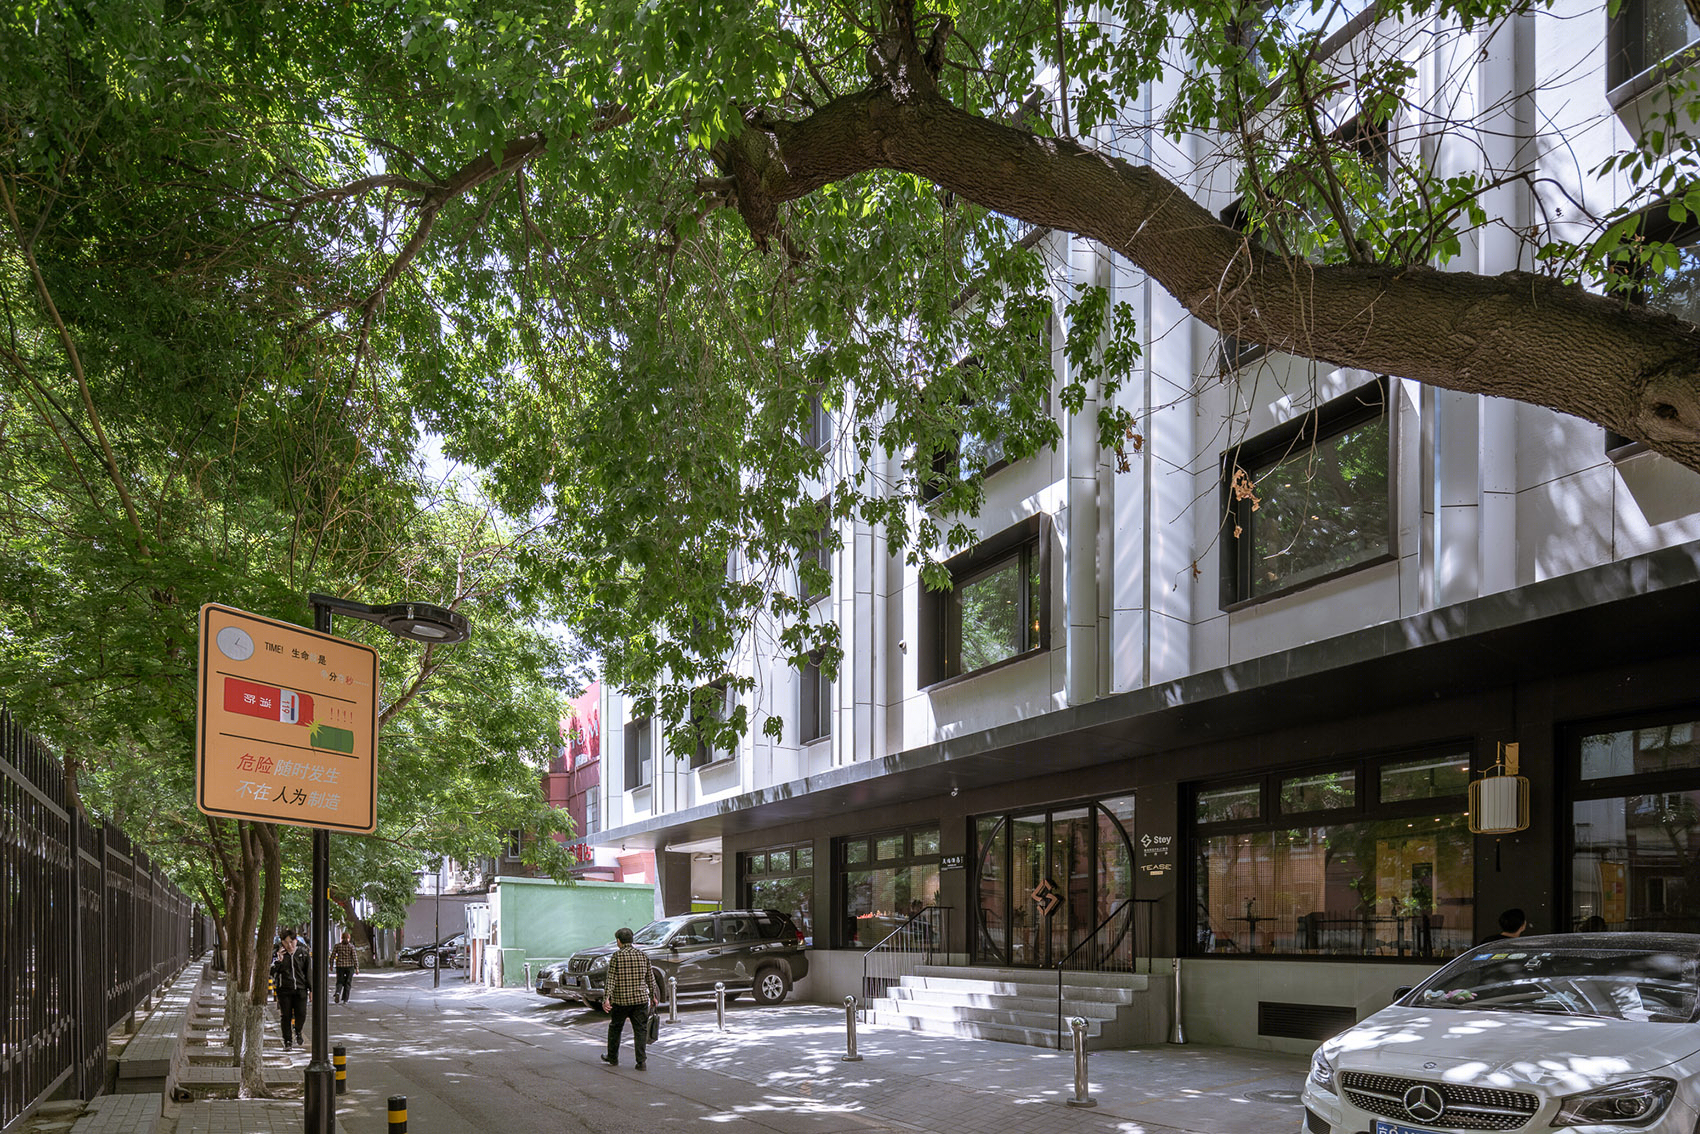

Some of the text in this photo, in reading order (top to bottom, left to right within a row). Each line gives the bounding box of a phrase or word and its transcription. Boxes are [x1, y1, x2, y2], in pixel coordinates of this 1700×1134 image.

[265, 641, 284, 655] TIME!
[282, 700, 290, 714] 119
[236, 752, 341, 784] 危险随时发生
[235, 780, 341, 811] 不在人为制造
[1140, 863, 1172, 871] TEASE
